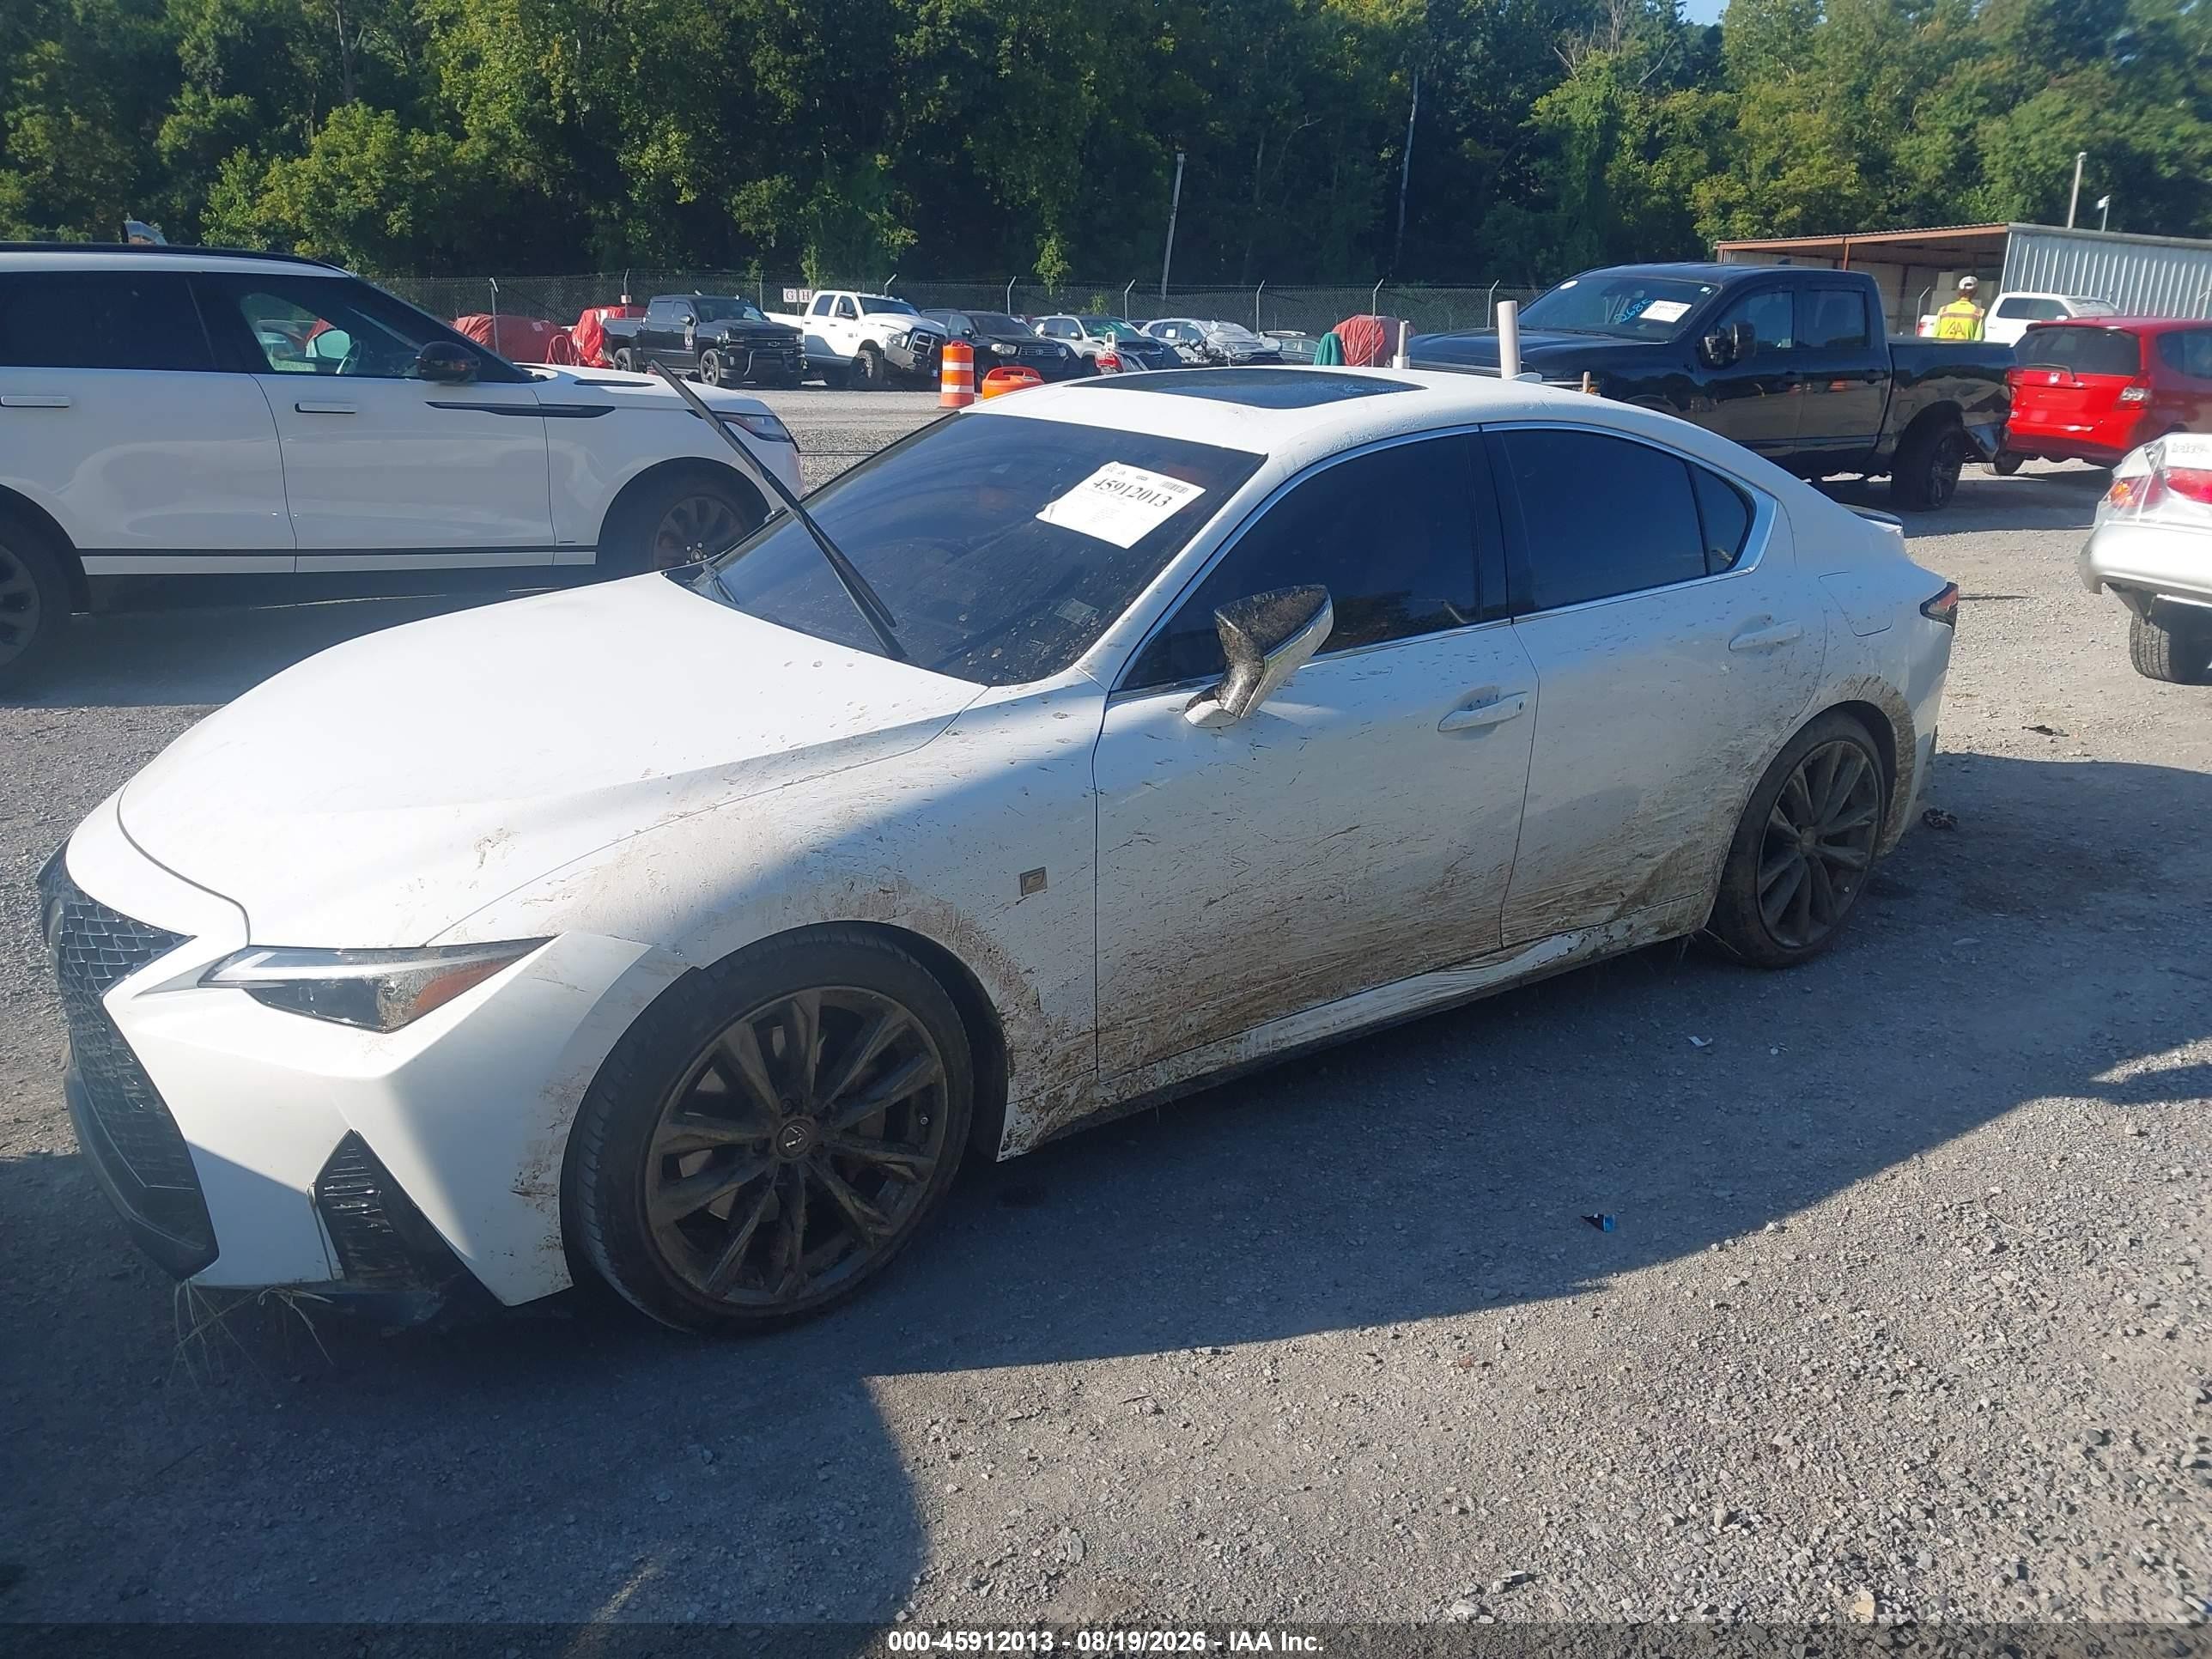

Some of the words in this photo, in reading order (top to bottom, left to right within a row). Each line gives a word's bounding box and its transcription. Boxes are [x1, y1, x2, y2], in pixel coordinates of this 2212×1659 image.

[786, 290, 794, 301] G
[802, 291, 810, 301] H
[1093, 477, 1173, 508] 45912013
